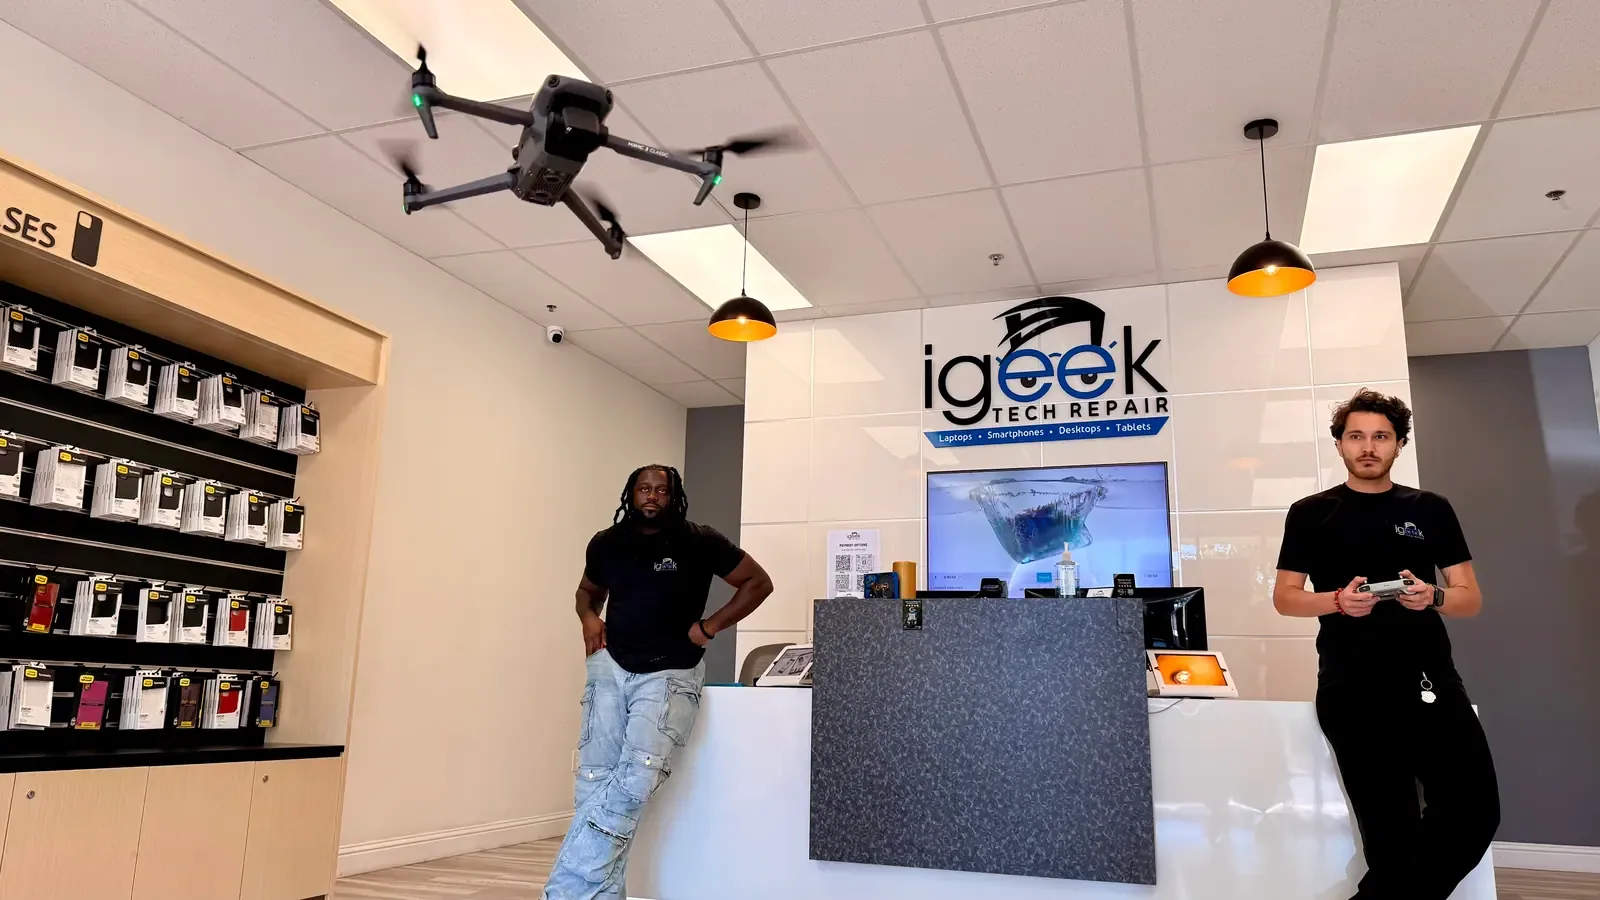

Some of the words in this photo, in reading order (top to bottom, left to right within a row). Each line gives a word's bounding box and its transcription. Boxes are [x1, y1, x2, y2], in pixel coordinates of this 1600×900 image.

[0, 207, 57, 248] SES
[992, 404, 1056, 423] TECH
[1070, 396, 1168, 418] REPAIR
[939, 432, 973, 443] Laptops
[987, 427, 1044, 440] Smartphones
[1059, 424, 1101, 435] Desktops
[1115, 422, 1151, 432] Tablets
